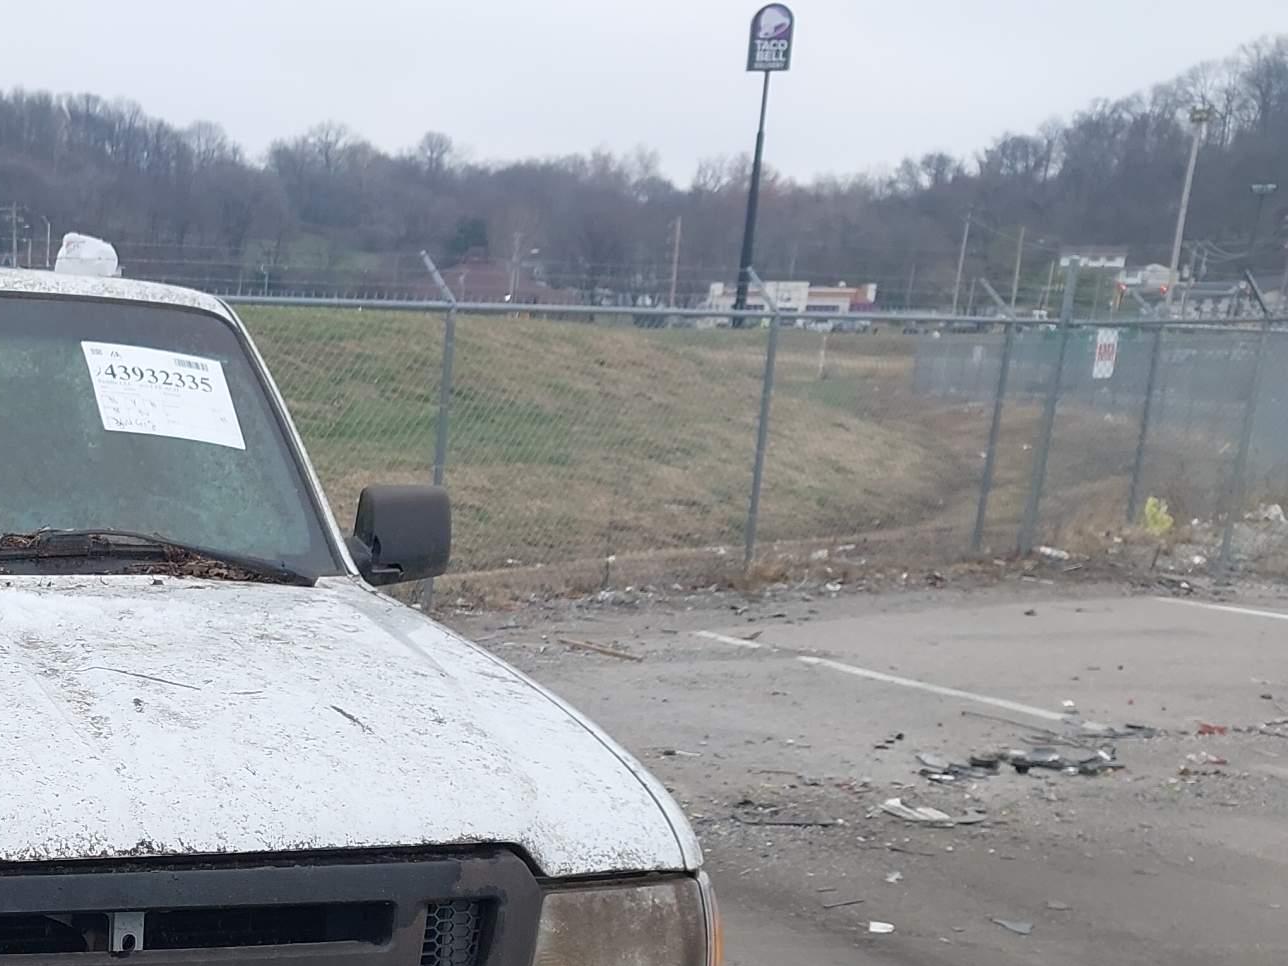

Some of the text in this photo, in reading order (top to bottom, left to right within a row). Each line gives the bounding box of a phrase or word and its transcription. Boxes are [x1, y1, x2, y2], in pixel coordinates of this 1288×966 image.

[754, 40, 788, 51] TACO
[755, 50, 787, 62] BELL
[104, 363, 213, 393] 43932335
